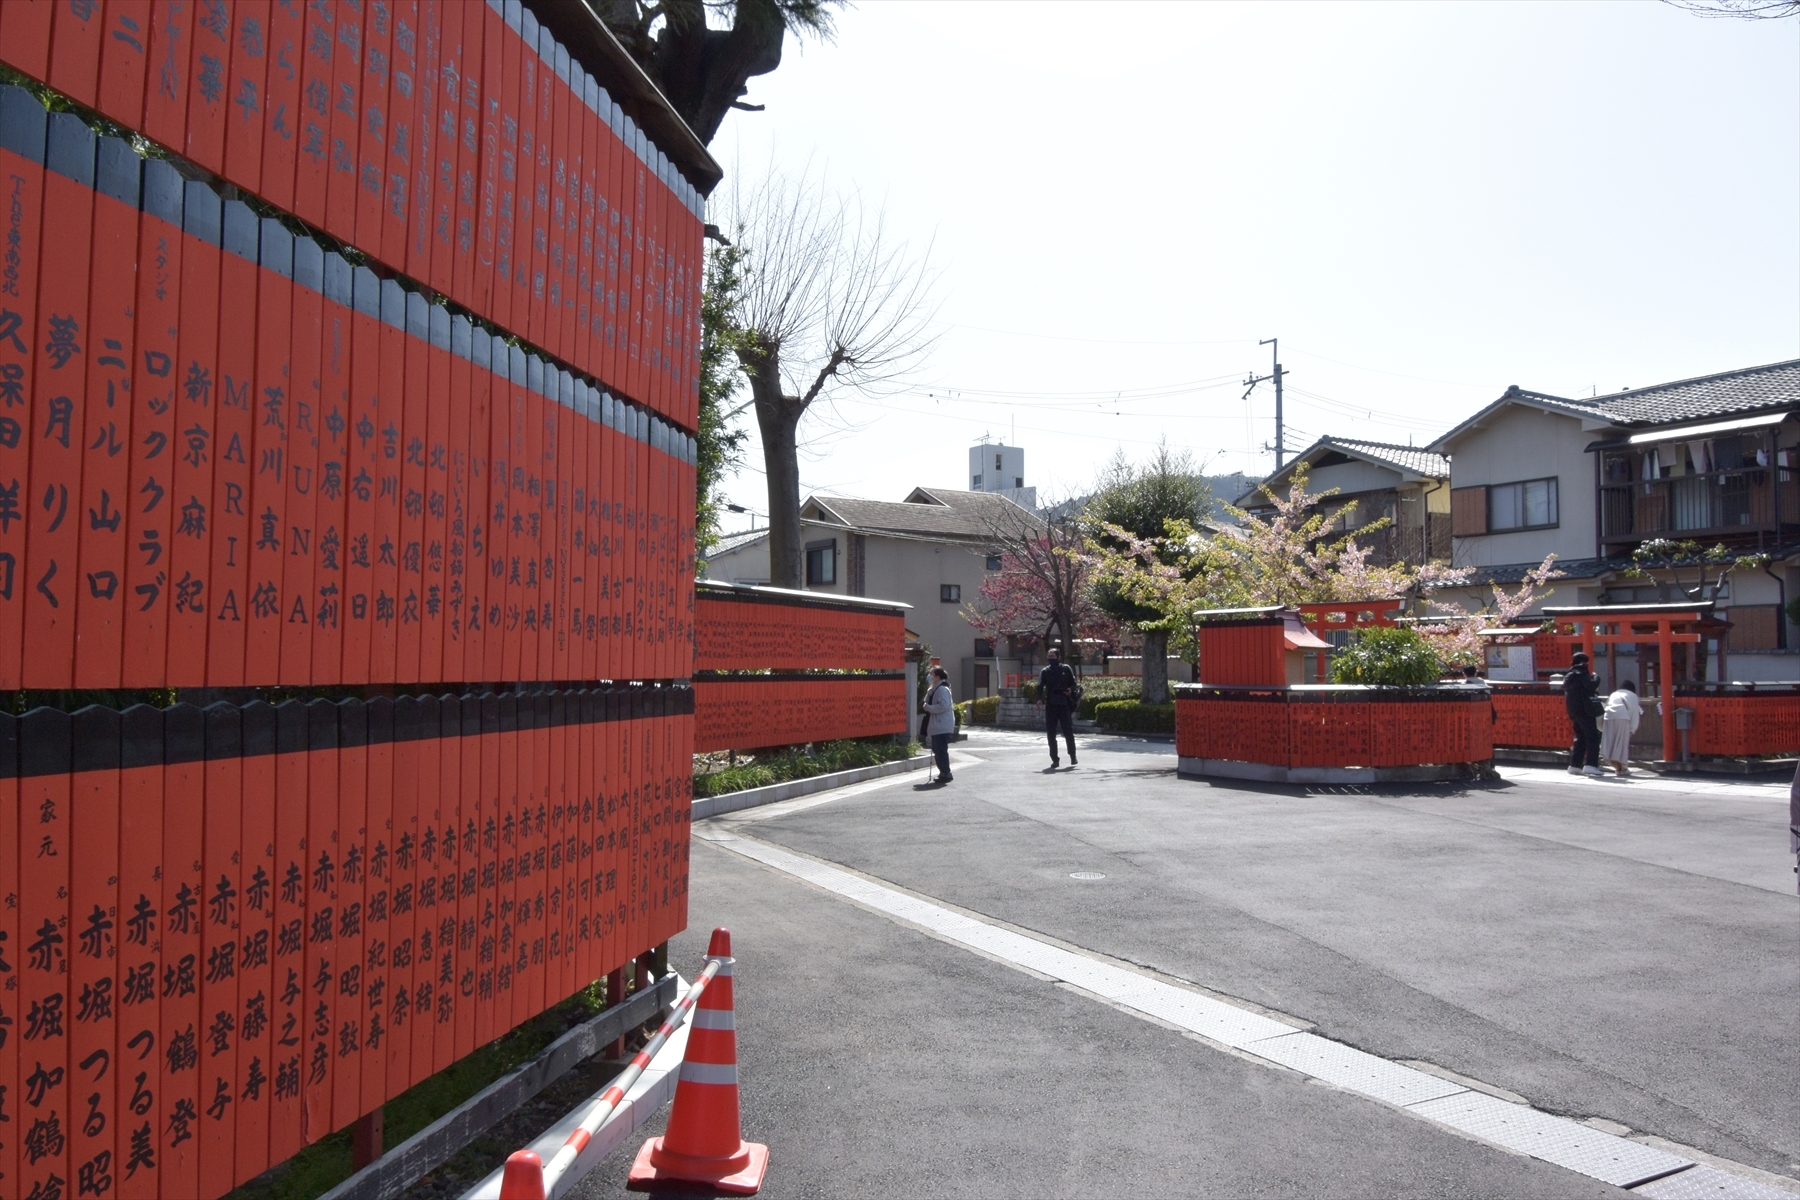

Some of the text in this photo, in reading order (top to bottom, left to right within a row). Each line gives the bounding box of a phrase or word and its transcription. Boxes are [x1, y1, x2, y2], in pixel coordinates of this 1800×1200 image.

[111, 13, 145, 55] 二
[2, 174, 25, 297] The東南西北
[154, 236, 169, 302] スタジオ
[641, 236, 656, 367] NAOYA
[36, 313, 82, 609] 夢月りく
[134, 350, 172, 612] ロッククラブ
[217, 374, 249, 622] MARIA
[251, 386, 285, 619] 荒川真依
[288, 401, 313, 624] RUNA
[316, 405, 346, 629] 中原愛莉
[375, 421, 399, 627] 吉川太郎
[401, 437, 425, 624] 北邨優衣
[468, 457, 487, 631] いちえ
[506, 466, 525, 631] 岡本美沙
[523, 473, 541, 633] 相澤真央
[38, 798, 58, 858] 家元
[415, 825, 437, 1015] 赤堀恵緒
[437, 824, 457, 1024] 赤堀繪美弥
[459, 817, 478, 998] 赤堀静也
[497, 811, 515, 993] 赤堀加奈緒
[531, 802, 547, 965] 赤堀秀朋
[547, 804, 564, 961] 伊藤京花
[564, 799, 578, 959] 加藤おりは
[604, 794, 618, 936] 松本理沙
[163, 882, 199, 1149] 赤堀鶴登
[205, 874, 237, 1121] 赤堀登与
[240, 865, 270, 1102] 赤堀藤寿
[274, 861, 303, 1102] 赤堀与之輔
[307, 850, 335, 1086] 赤堀与志彦
[338, 843, 362, 1058] 赤堀昭敦
[364, 840, 389, 1051] 赤堀紀世寿
[391, 831, 414, 1027] 赤堀昭奈
[76, 905, 113, 1199] 赤堀つる昭
[121, 893, 157, 1181] 赤堀つる美
